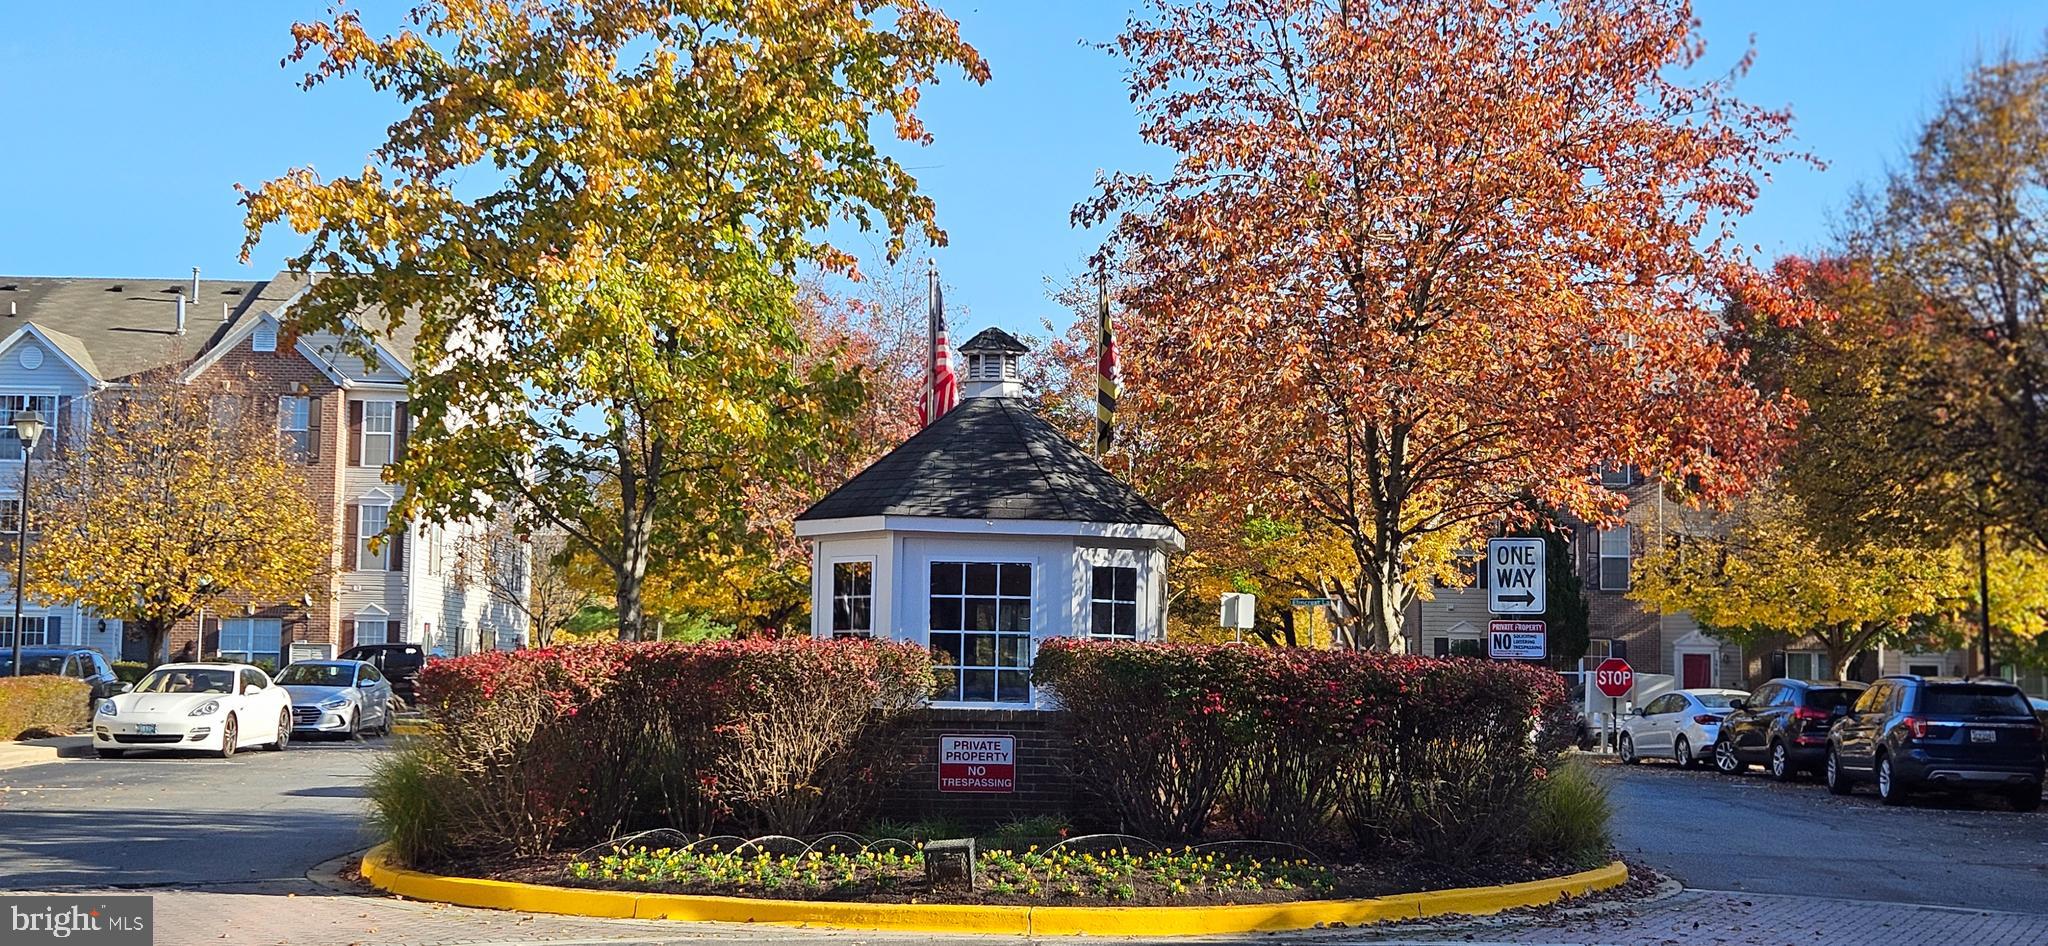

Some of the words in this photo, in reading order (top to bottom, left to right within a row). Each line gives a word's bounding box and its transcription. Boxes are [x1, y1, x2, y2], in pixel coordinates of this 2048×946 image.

[1497, 546, 1536, 565] ONE
[1496, 568, 1537, 588] WAY
[1492, 623, 1514, 631] PRIVATE
[1515, 623, 1543, 632] PROPERTY
[1493, 633, 1512, 650] NO
[1598, 670, 1631, 685] STOP
[953, 741, 1001, 751] PRIVATE
[946, 751, 1009, 762] PROPERTY
[968, 766, 986, 776] NO
[942, 777, 1012, 788] TRESPASSING
